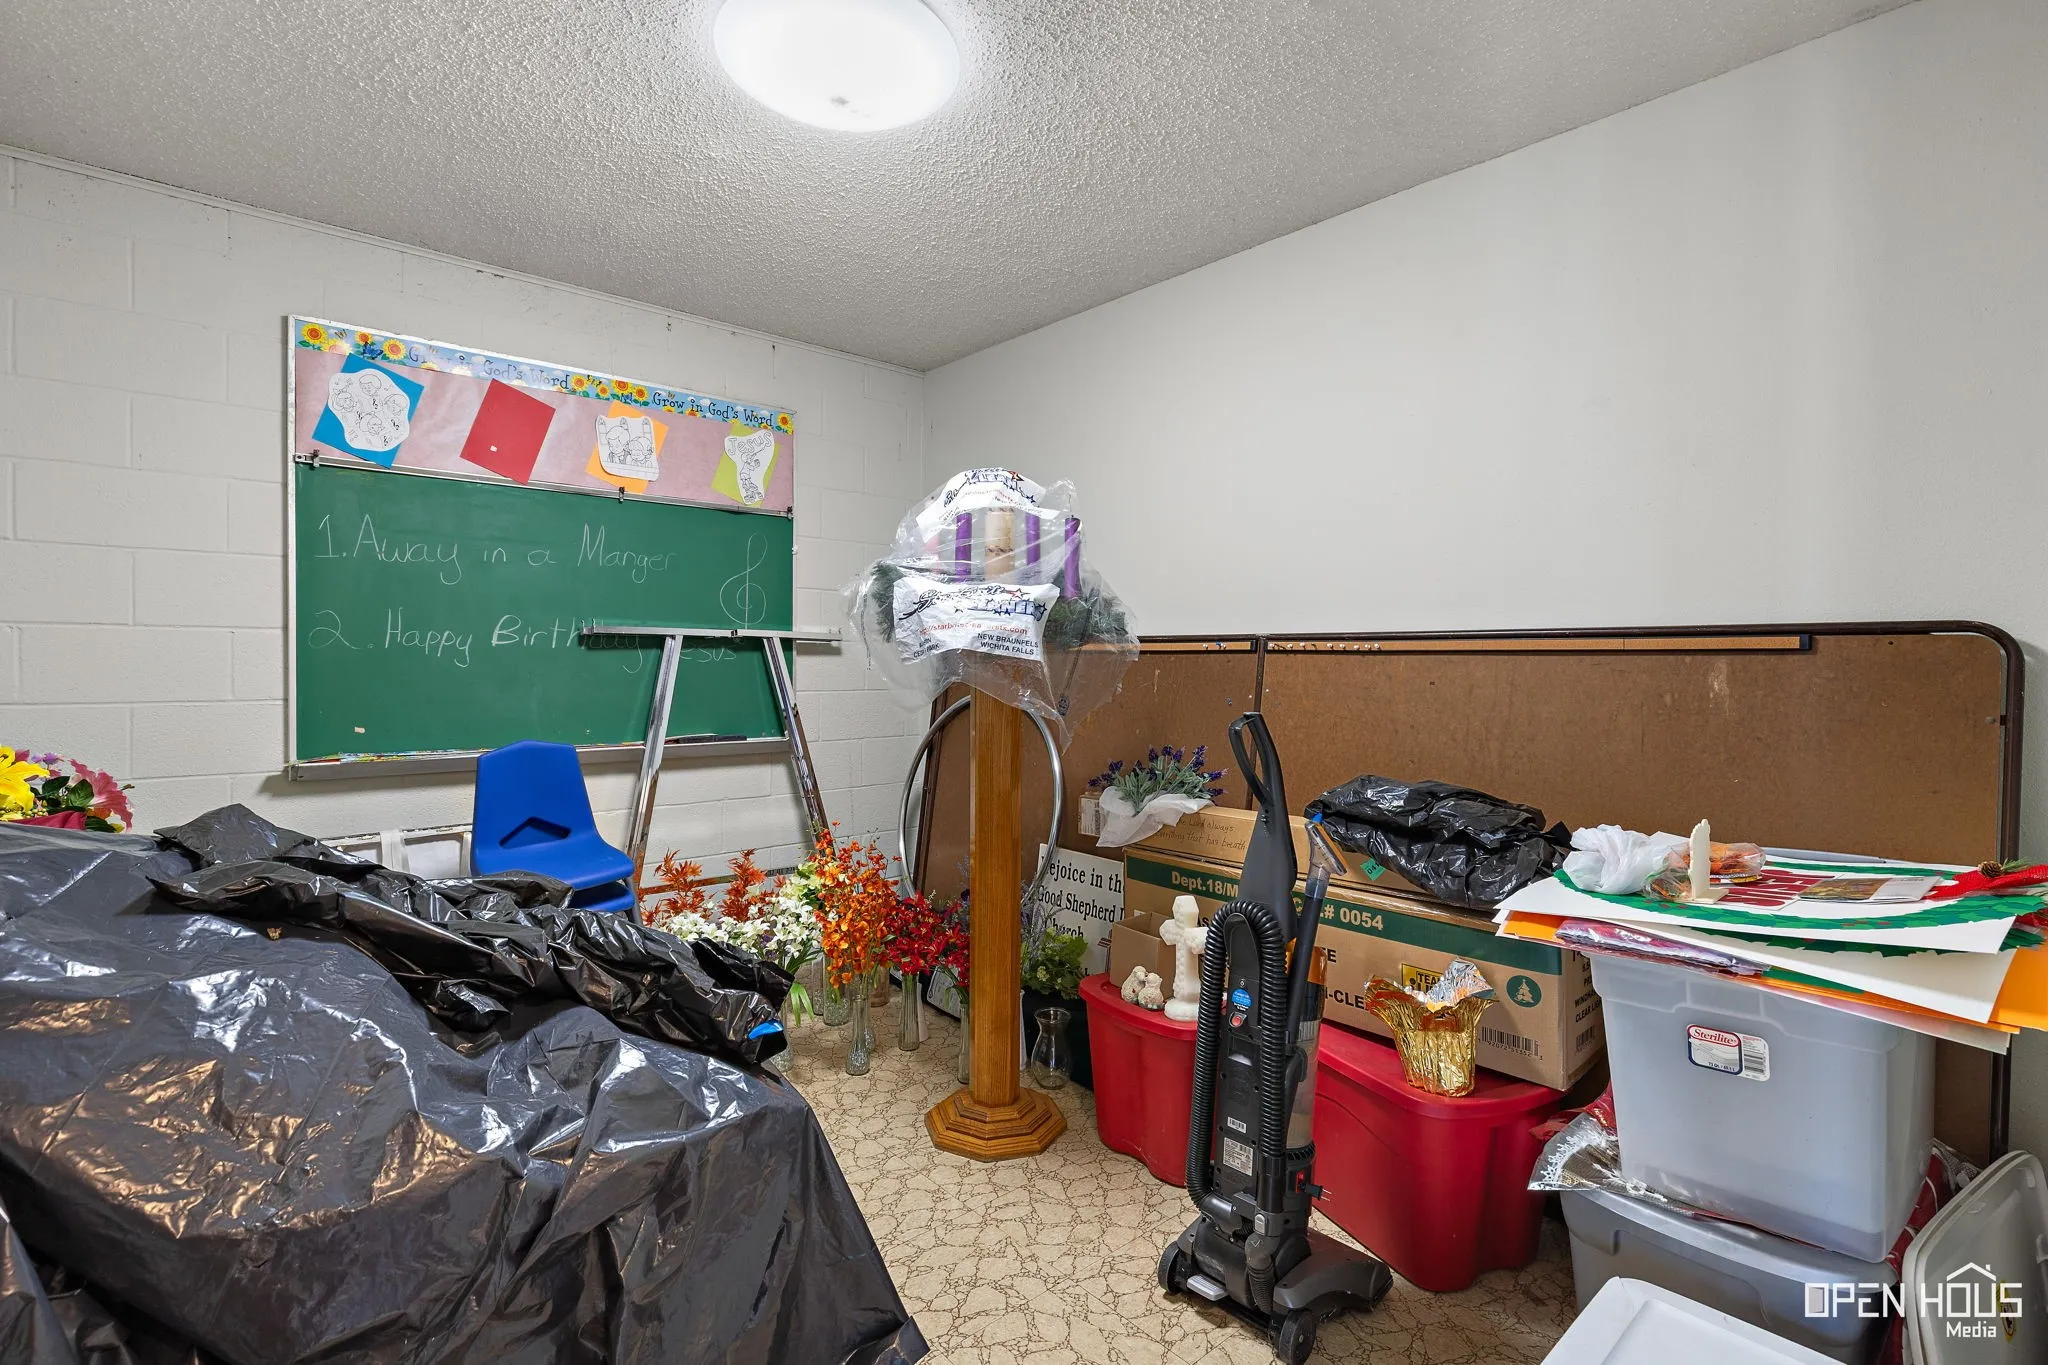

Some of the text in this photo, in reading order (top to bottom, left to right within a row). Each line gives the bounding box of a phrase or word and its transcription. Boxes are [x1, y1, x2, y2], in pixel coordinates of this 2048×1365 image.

[530, 367, 570, 390] Word
[652, 391, 773, 427] Grow in God's Word
[727, 431, 772, 456] Jesus
[353, 513, 462, 585] Away
[483, 547, 507, 563] in
[527, 549, 557, 566] a
[577, 522, 677, 584] Manger
[385, 606, 473, 668] Happy
[977, 633, 1040, 649] NEW BRAUNFELS
[980, 641, 1035, 656] WICHITA FALLS
[1206, 820, 1234, 834] always
[1221, 838, 1246, 850] breath
[1041, 856, 1124, 894] ejoice in th
[1038, 885, 1064, 908] Good
[1065, 892, 1117, 923] Shepherd
[1339, 907, 1384, 931] 0054
[1417, 972, 1440, 986] TEA
[1693, 1028, 1735, 1045] Sterilite
